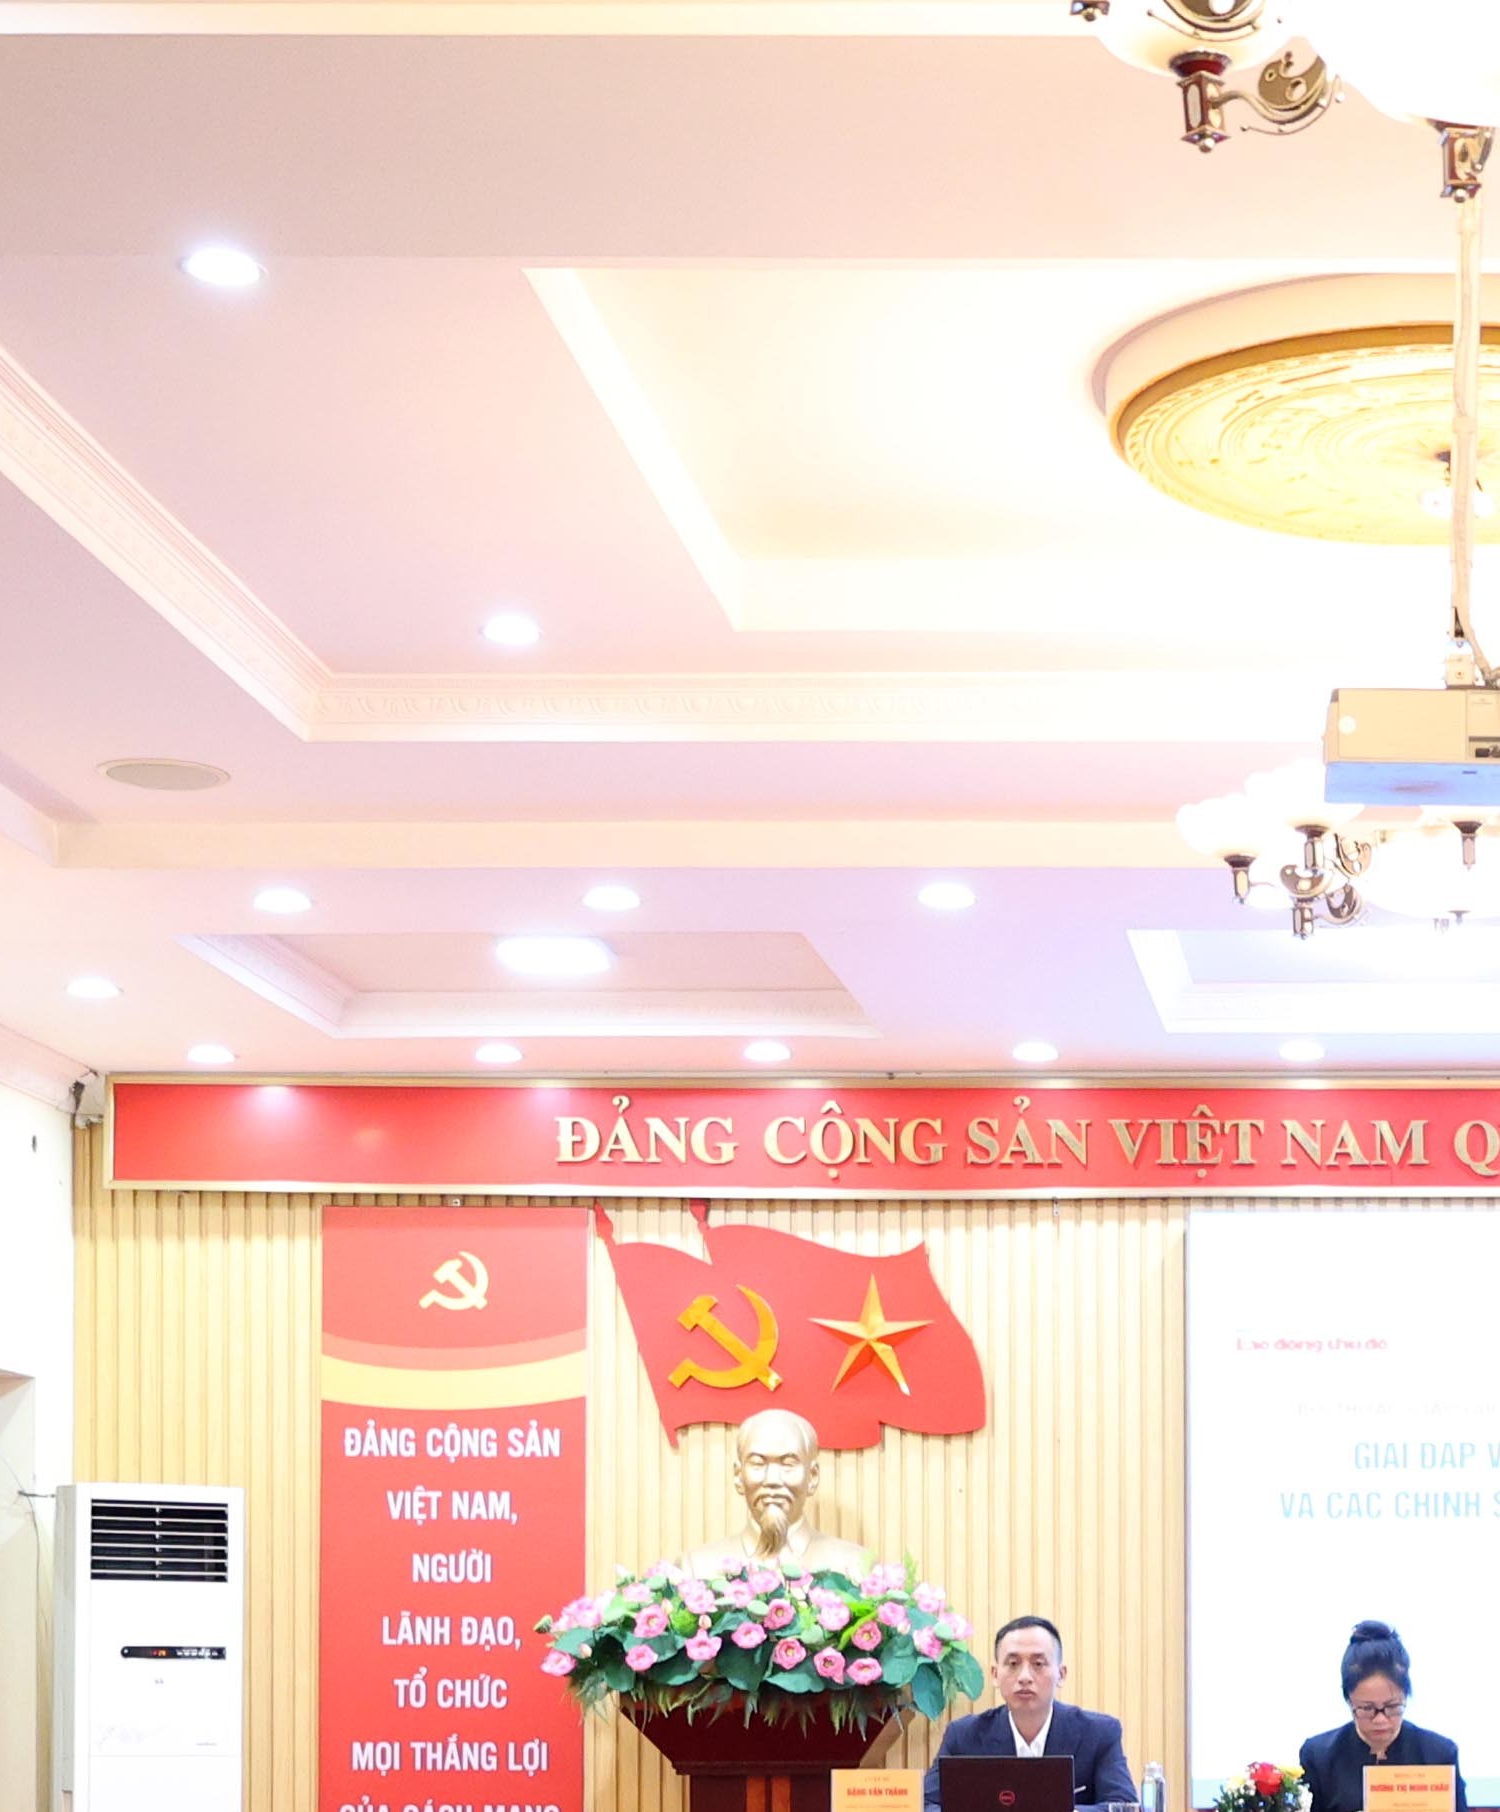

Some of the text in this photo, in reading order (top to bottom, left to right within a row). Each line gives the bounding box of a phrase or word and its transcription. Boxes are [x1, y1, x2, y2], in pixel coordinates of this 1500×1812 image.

[555, 1093, 738, 1168] ĐẢNG
[762, 1099, 948, 1180] CỘNG
[965, 1093, 1089, 1168] SẢN
[1111, 1106, 1265, 1180] VIỆT
[1281, 1119, 1429, 1168] NAM
[344, 1418, 561, 1463] ĐẢNG CỘNG SẢN
[387, 1485, 518, 1528] VIỆT NAM,
[412, 1547, 492, 1584] NGƯỜI
[383, 1610, 521, 1652] LÃNH ĐẠO,
[394, 1666, 507, 1709] TỔ CHỨC
[352, 1731, 548, 1777] MỌI THẮNG LỢI
